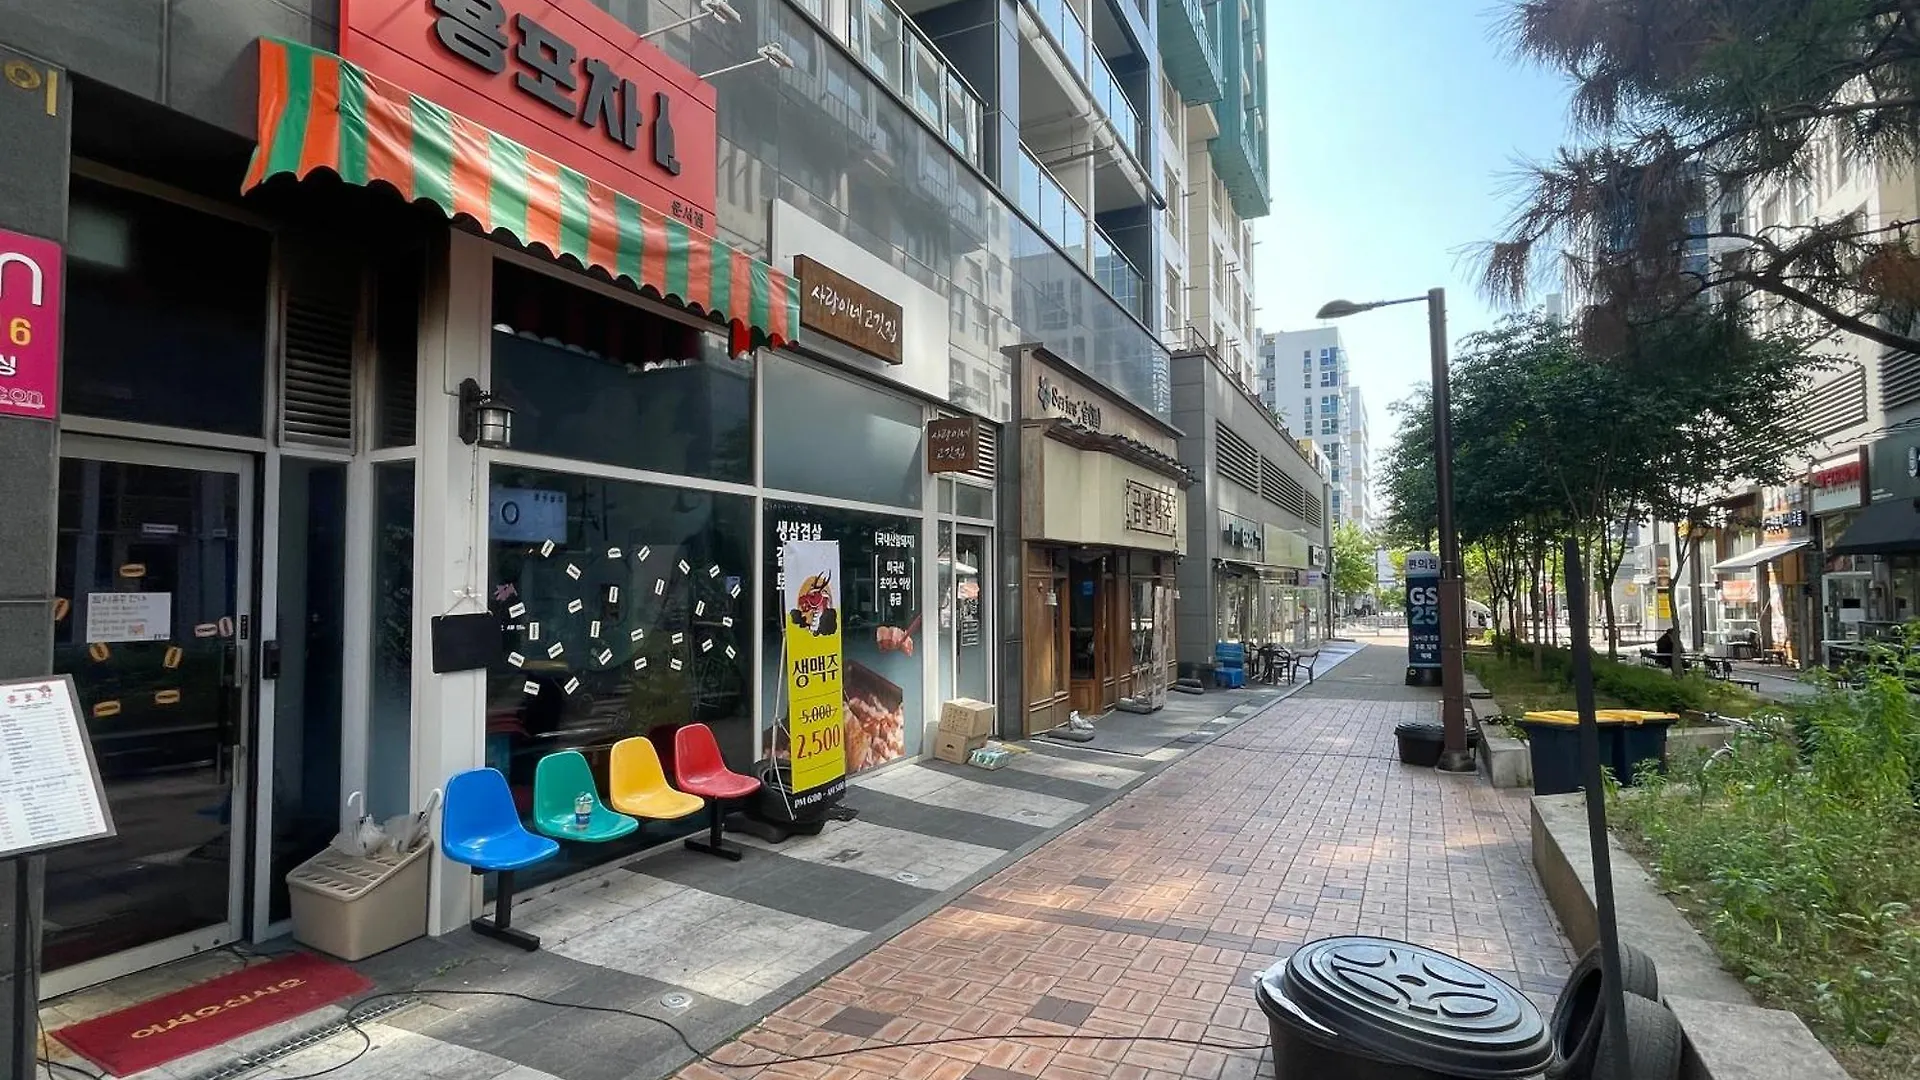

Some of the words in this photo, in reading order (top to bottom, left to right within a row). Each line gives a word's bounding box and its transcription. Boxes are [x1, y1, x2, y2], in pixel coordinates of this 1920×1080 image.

[776, 520, 822, 541] 생삼겹살
[1408, 558, 1437, 570] 편의점
[1410, 587, 1438, 606] GS
[1411, 606, 1438, 625] 25
[793, 654, 838, 688] 생맥주
[796, 724, 841, 760] 2,500
